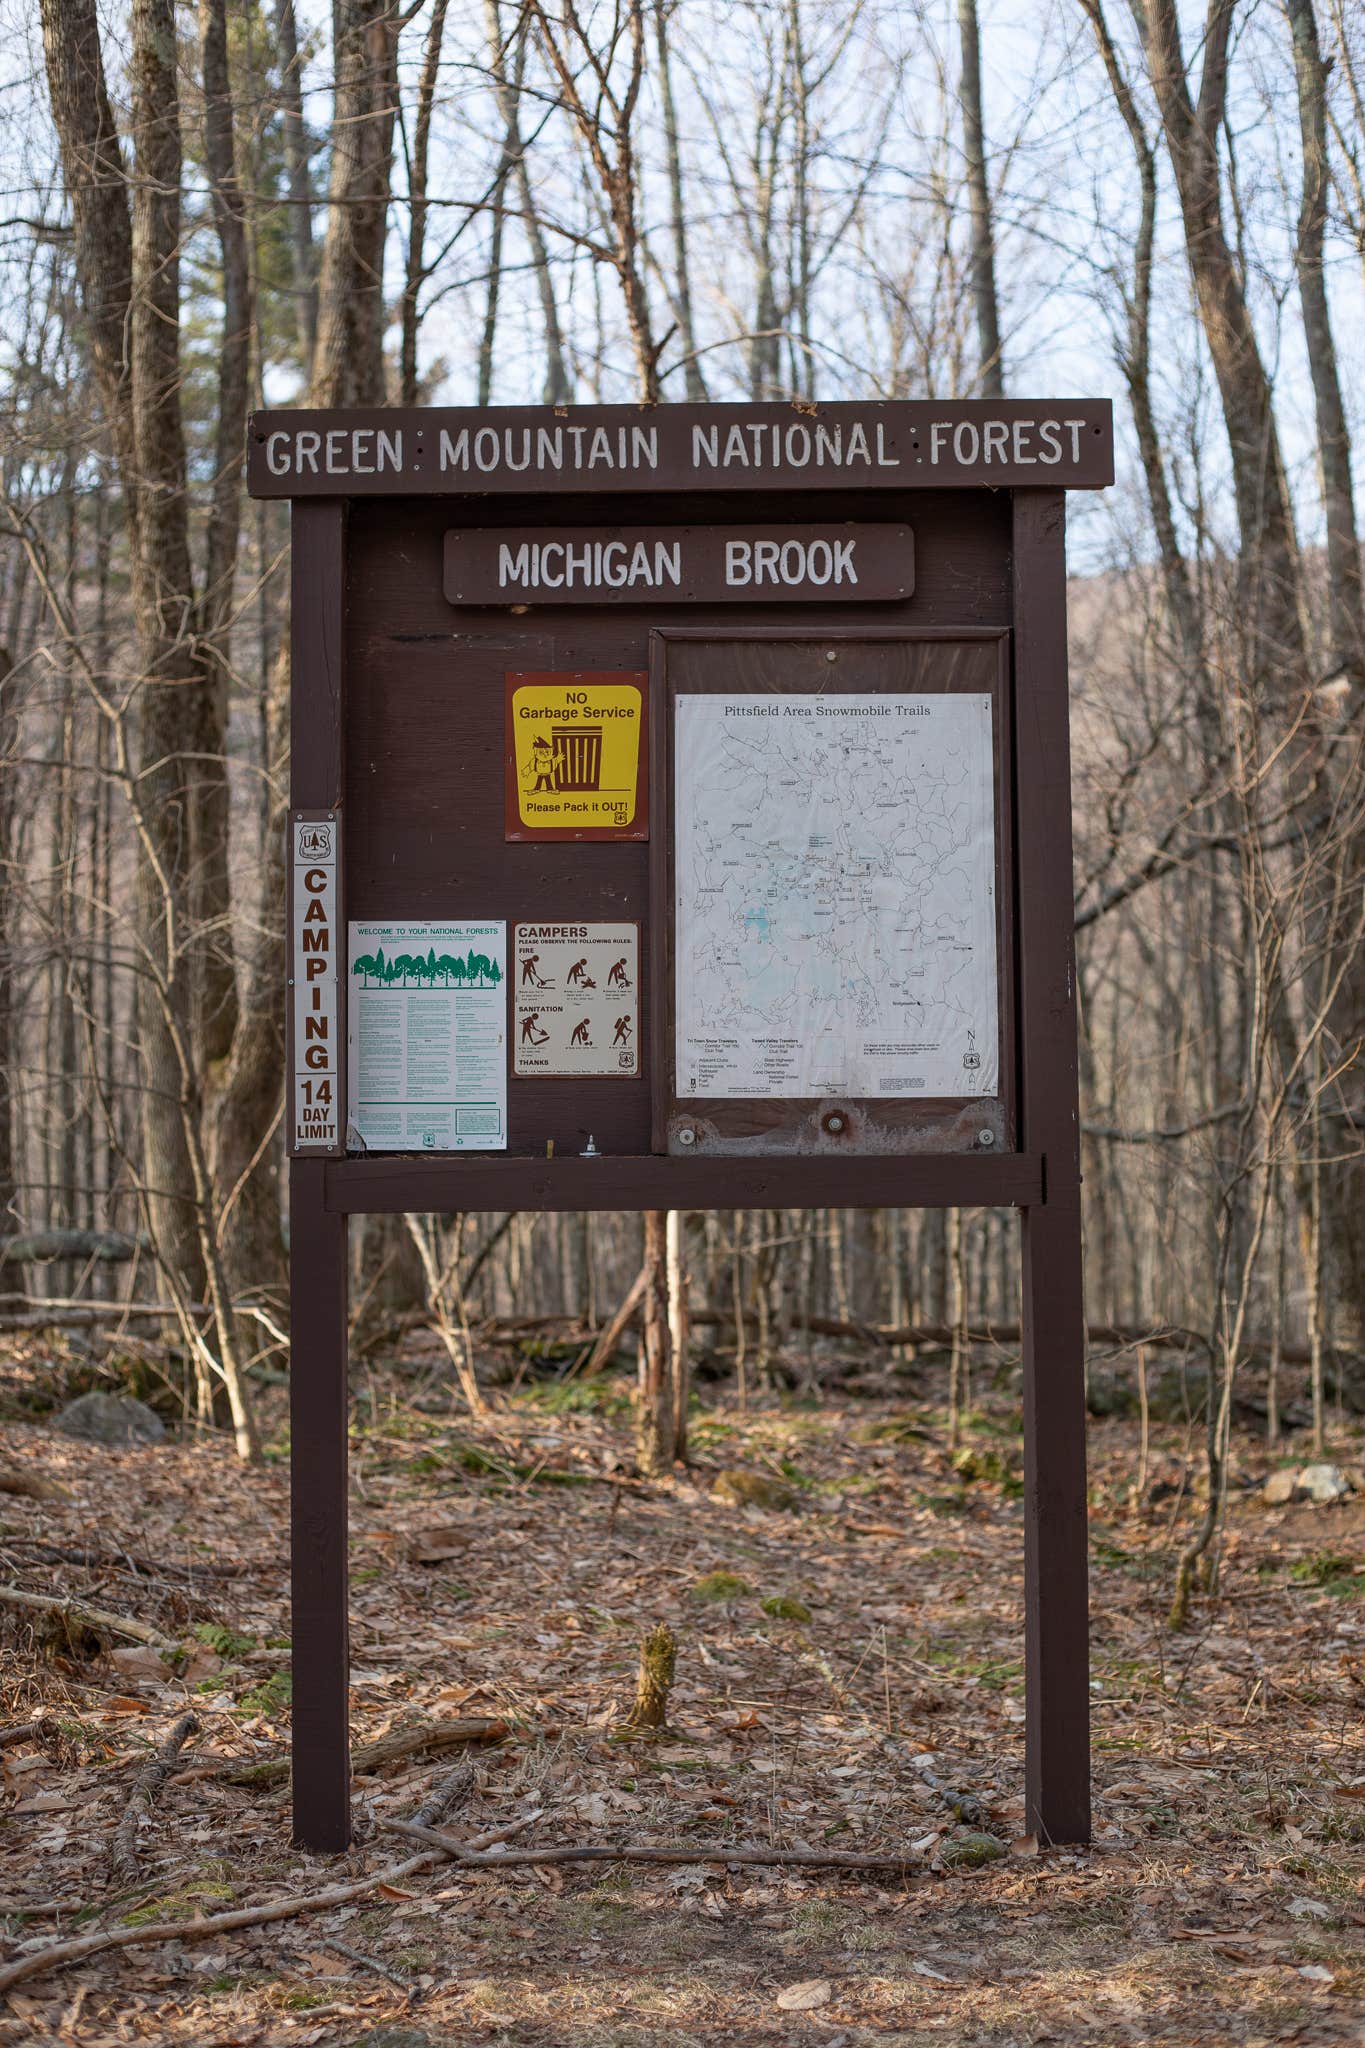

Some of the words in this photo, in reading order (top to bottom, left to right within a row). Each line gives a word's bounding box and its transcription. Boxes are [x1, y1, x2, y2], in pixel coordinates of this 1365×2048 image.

[266, 429, 402, 475] GREEN
[439, 426, 658, 472] MOUNTAIN
[692, 422, 900, 468] NATIONAL
[930, 420, 1086, 465] FOREST
[499, 541, 681, 588] MICHIGAN
[725, 540, 858, 585] BROOK
[566, 692, 587, 704] NO
[519, 707, 579, 721] Garbage
[583, 706, 635, 718] Service
[724, 706, 779, 716] Pittsfield
[783, 706, 812, 716] Area
[816, 705, 891, 716] Snowmobile
[895, 705, 931, 716] Trails
[526, 803, 560, 812] Please
[564, 802, 589, 812] Pack
[592, 802, 599, 811] it
[602, 802, 628, 811] OUT!
[518, 927, 588, 937] CAMPERS
[302, 868, 329, 1070] CAMPING
[967, 1030, 975, 1040] N
[301, 1080, 332, 1105] 14
[303, 1108, 330, 1121] DAY
[297, 1125, 335, 1138] LIMIT
